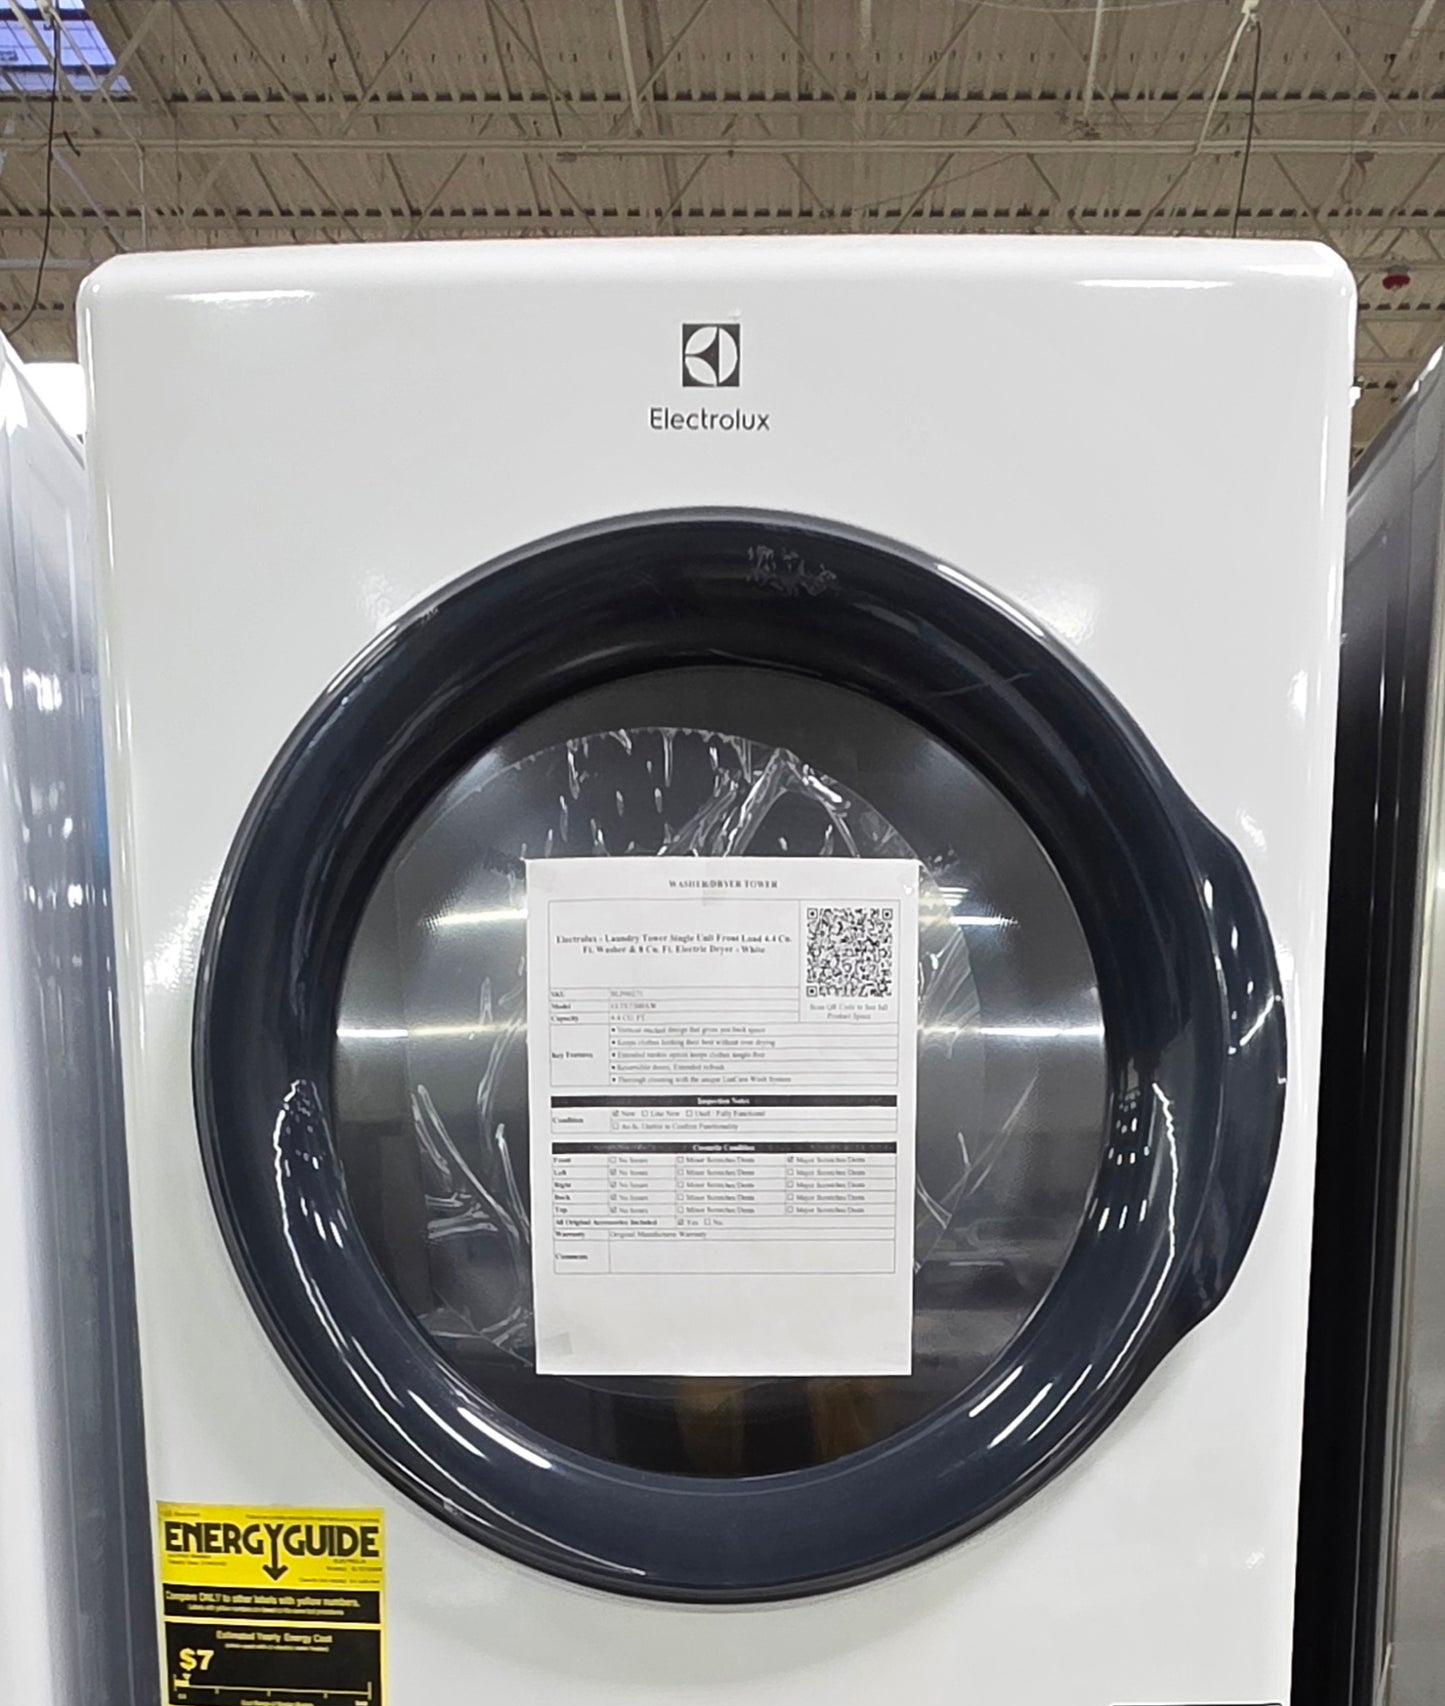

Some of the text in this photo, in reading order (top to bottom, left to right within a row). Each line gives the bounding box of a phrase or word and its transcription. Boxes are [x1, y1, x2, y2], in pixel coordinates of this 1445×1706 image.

[650, 408, 770, 431] Electrolux
[745, 880, 778, 888] TOWER
[556, 934, 597, 944] Electrolux
[604, 934, 639, 944] Laundry
[642, 934, 668, 943] Tower
[716, 933, 740, 942] Front
[596, 945, 626, 954] Washer
[675, 945, 707, 953] Electric
[709, 944, 734, 955] Dryer
[741, 944, 766, 953] White
[165, 1521, 380, 1558] ENERGYGUIDE
[179, 1646, 215, 1671] $7
